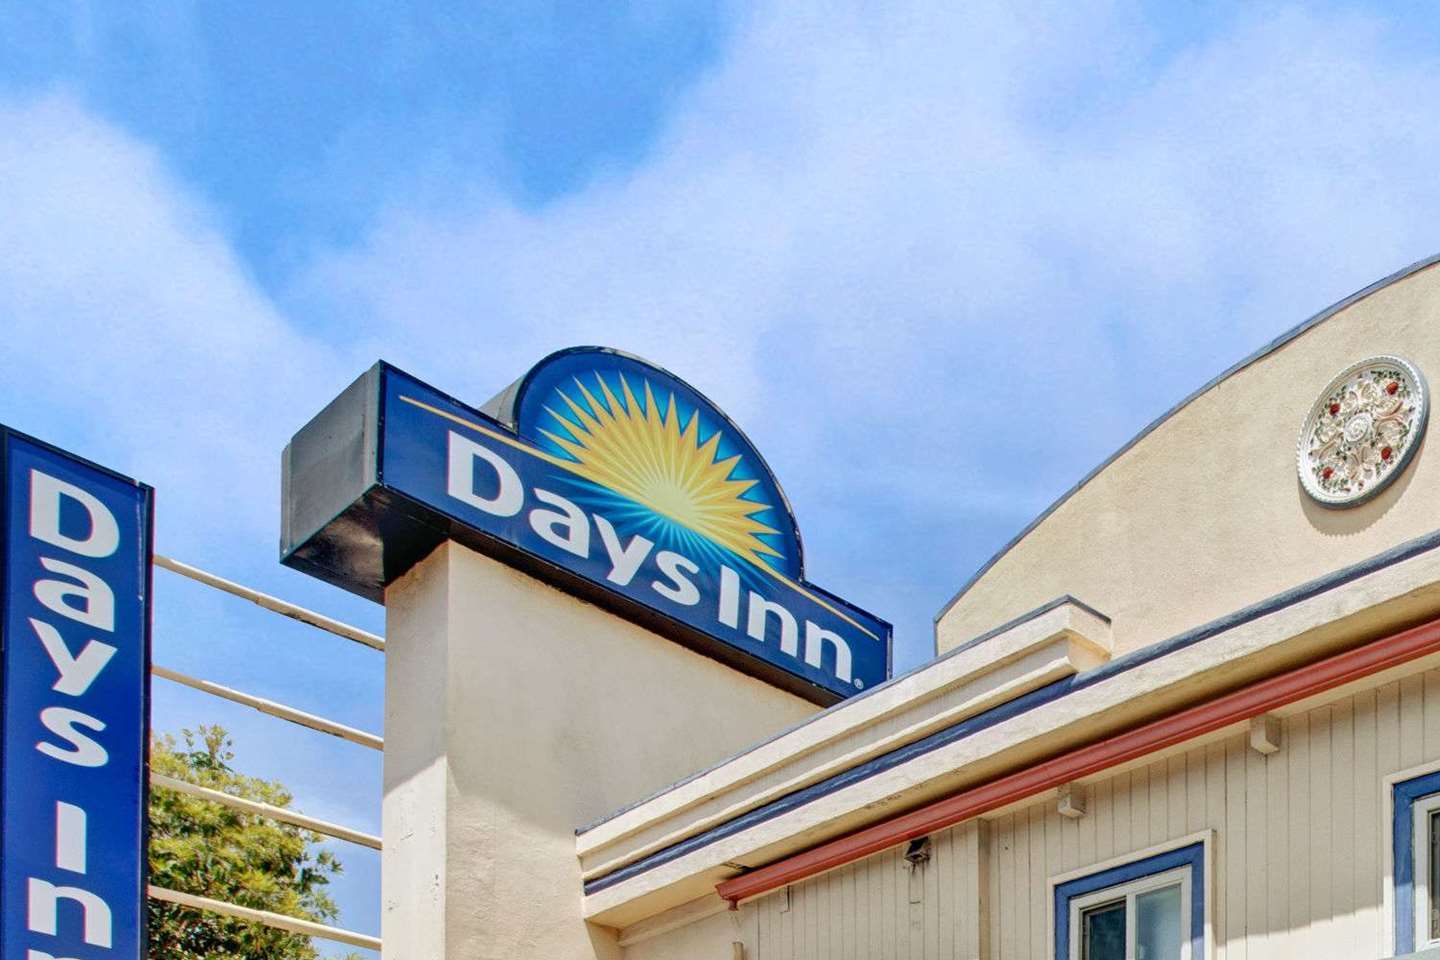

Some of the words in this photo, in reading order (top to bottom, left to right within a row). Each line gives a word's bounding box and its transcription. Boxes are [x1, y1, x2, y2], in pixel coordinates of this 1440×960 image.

[29, 468, 120, 767] Days
[447, 430, 700, 607] Days
[719, 565, 853, 684] Inn
